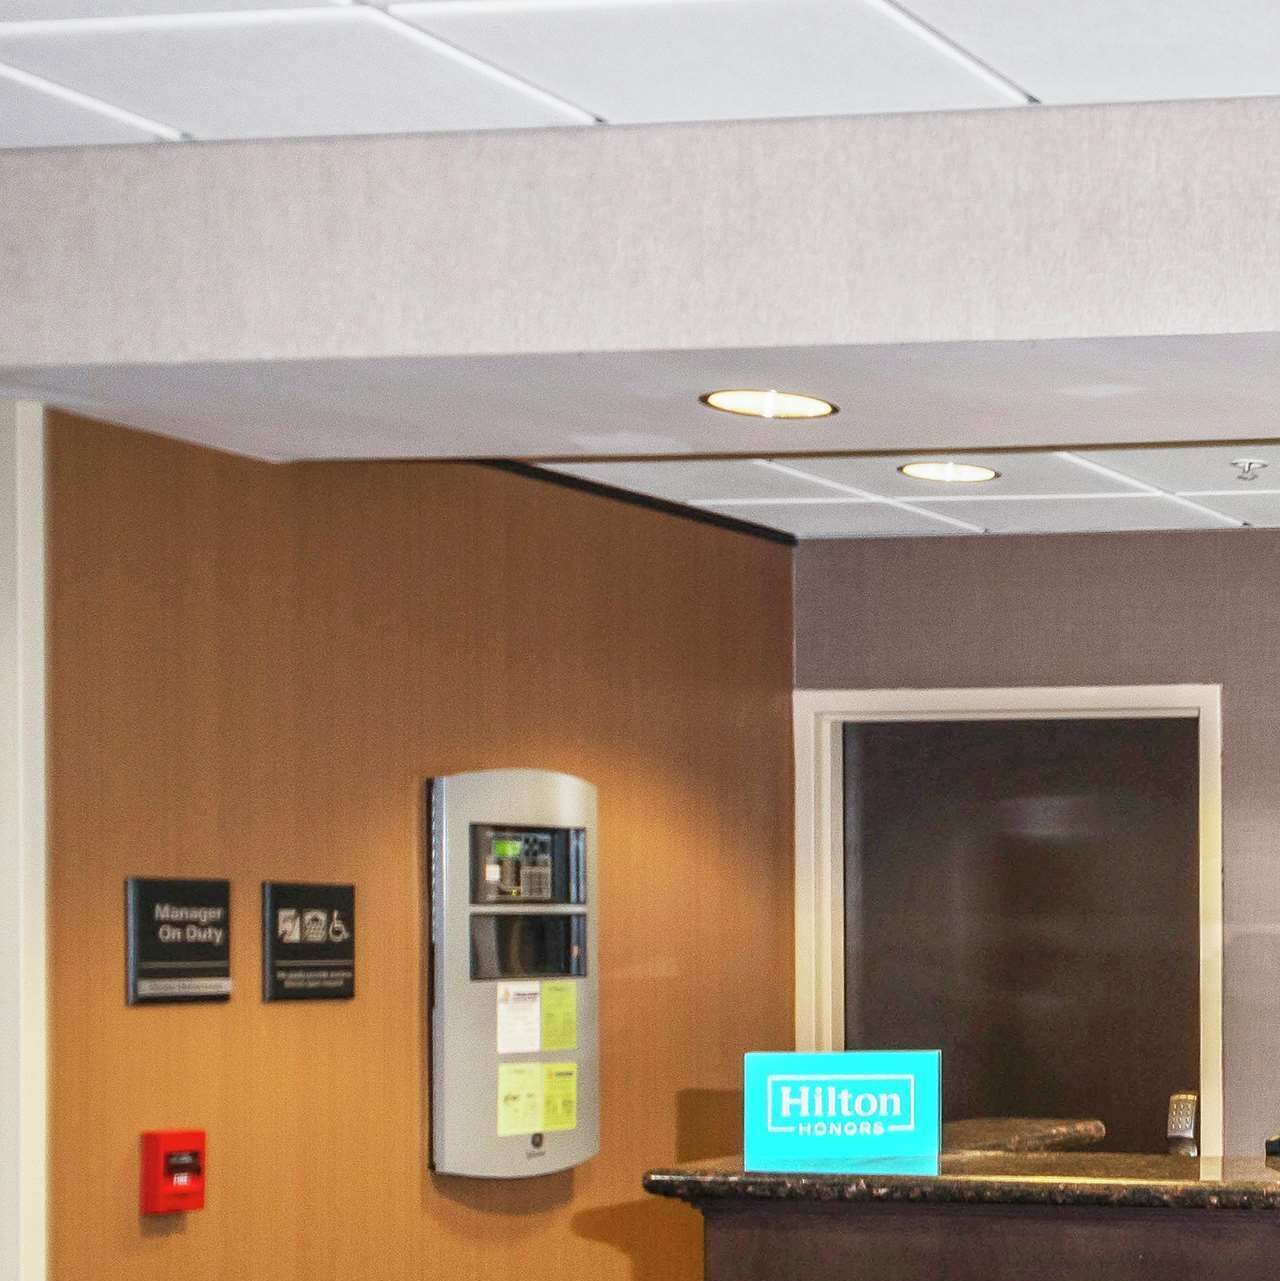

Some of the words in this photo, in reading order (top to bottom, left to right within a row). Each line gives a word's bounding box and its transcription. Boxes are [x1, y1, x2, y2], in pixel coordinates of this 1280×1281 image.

[154, 903, 223, 926] Manager
[158, 924, 182, 943] On
[186, 924, 224, 946] Duty
[781, 1086, 902, 1118] Hilton
[799, 1121, 885, 1136] HONORS
